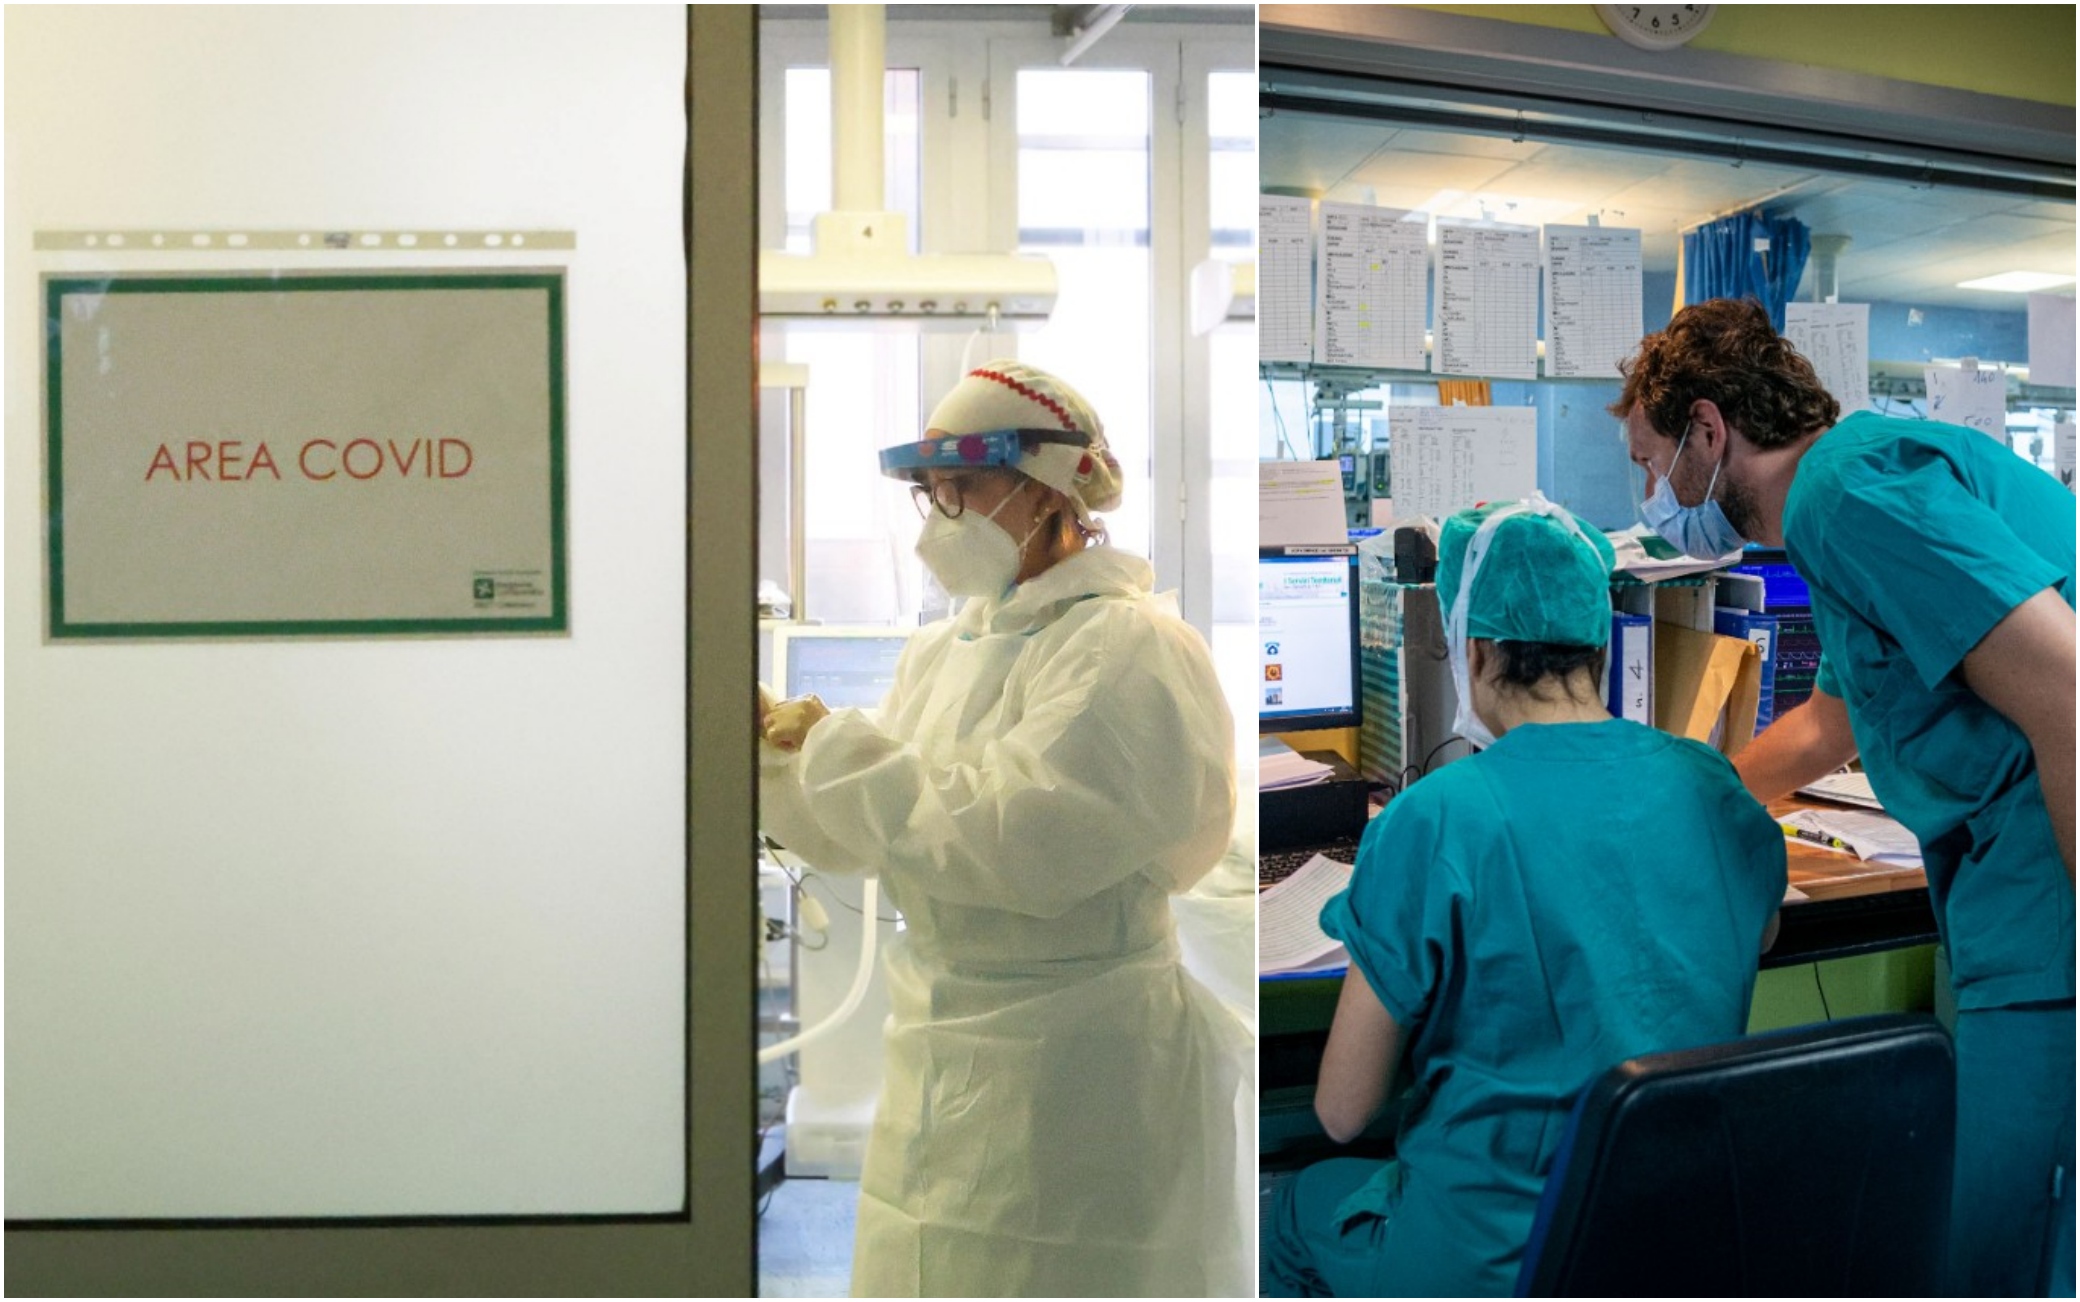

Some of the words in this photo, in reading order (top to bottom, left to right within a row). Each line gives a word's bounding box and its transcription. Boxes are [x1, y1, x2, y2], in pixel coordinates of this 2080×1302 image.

[1632, 7, 1640, 19] 7
[1671, 13, 1680, 26] 5
[1651, 16, 1660, 28] 6
[145, 440, 281, 481] AREA
[299, 438, 473, 480] COVID
[1629, 659, 1644, 680] 4
